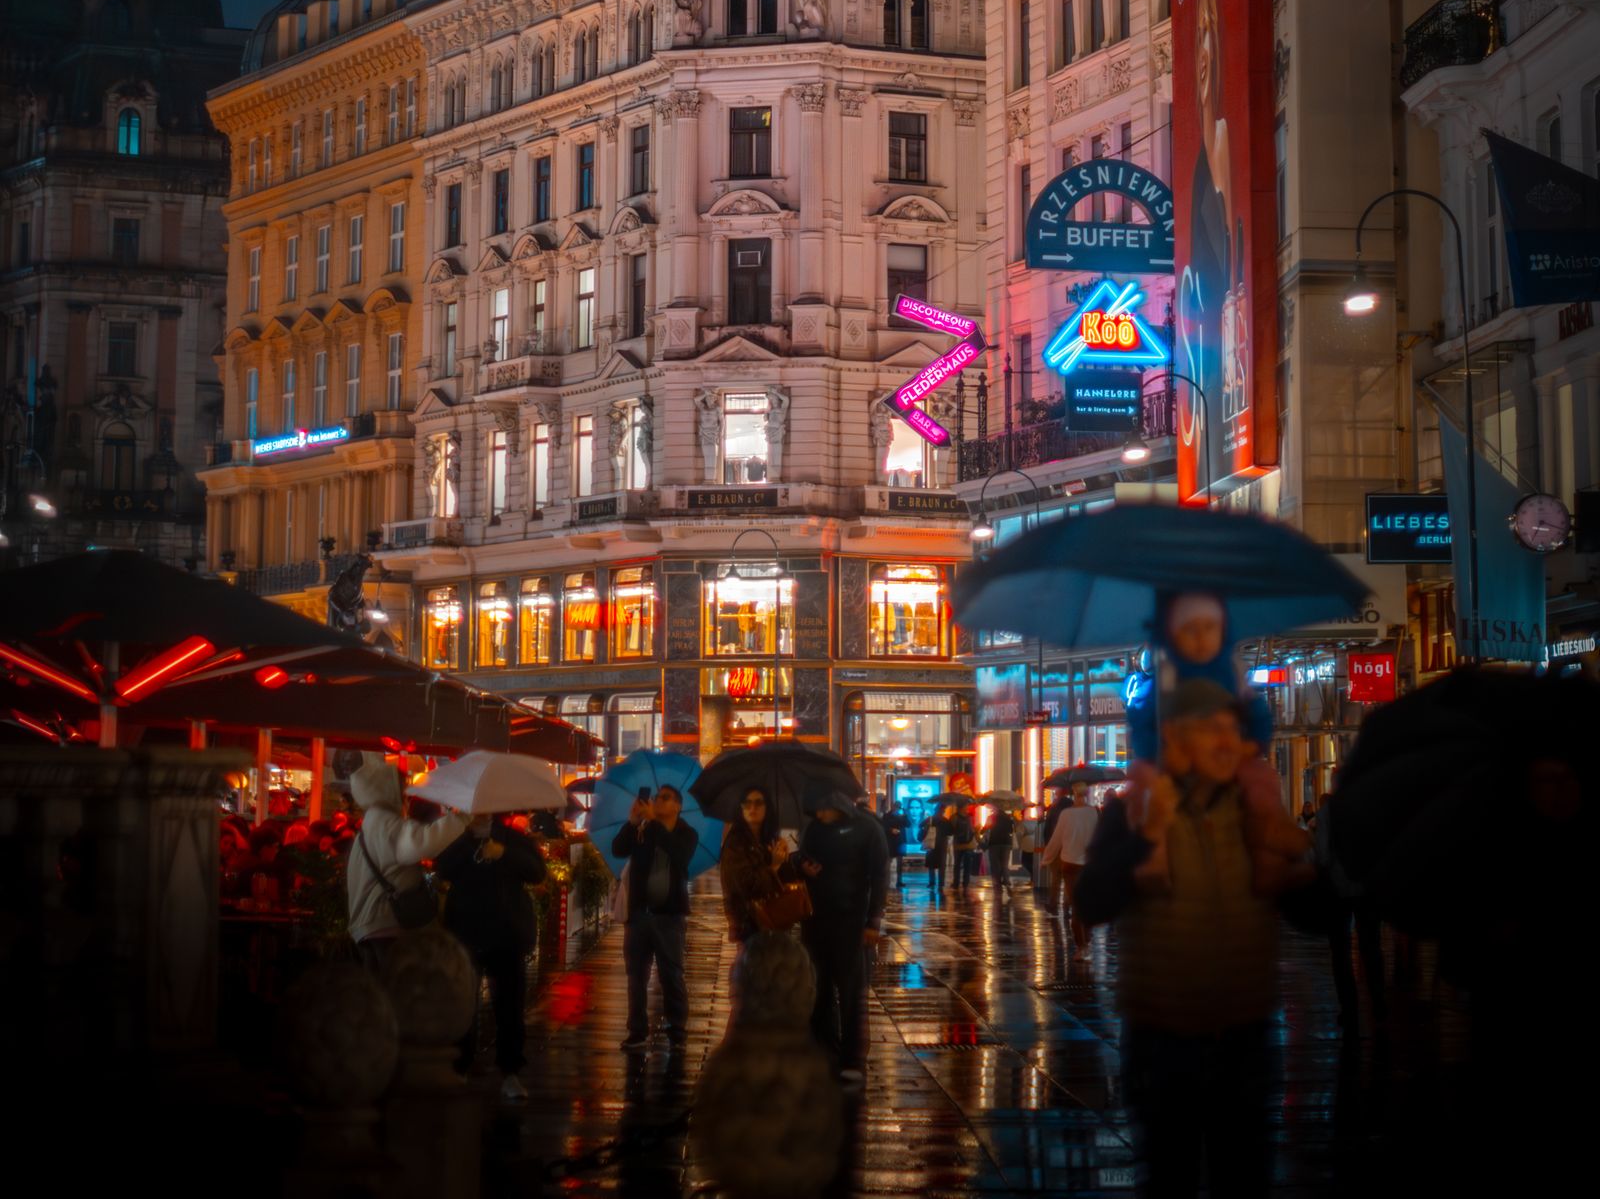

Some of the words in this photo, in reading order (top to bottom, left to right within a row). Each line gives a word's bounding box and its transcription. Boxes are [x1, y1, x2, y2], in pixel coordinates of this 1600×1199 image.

[1066, 227, 1154, 249] BUFFET
[902, 299, 972, 331] DISCOTHEQUE
[900, 345, 975, 407] FLEDERMAUS
[920, 357, 946, 380] CABARET
[1075, 388, 1137, 399] HANNELORE
[1093, 406, 1111, 414] living
[911, 411, 931, 430] BAR
[709, 493, 744, 505] BRAUN
[908, 495, 941, 509] BRAUN
[1372, 514, 1450, 529] LIEBES
[1459, 617, 1544, 644] LISKA
[1552, 637, 1596, 657] LIEBESKIND
